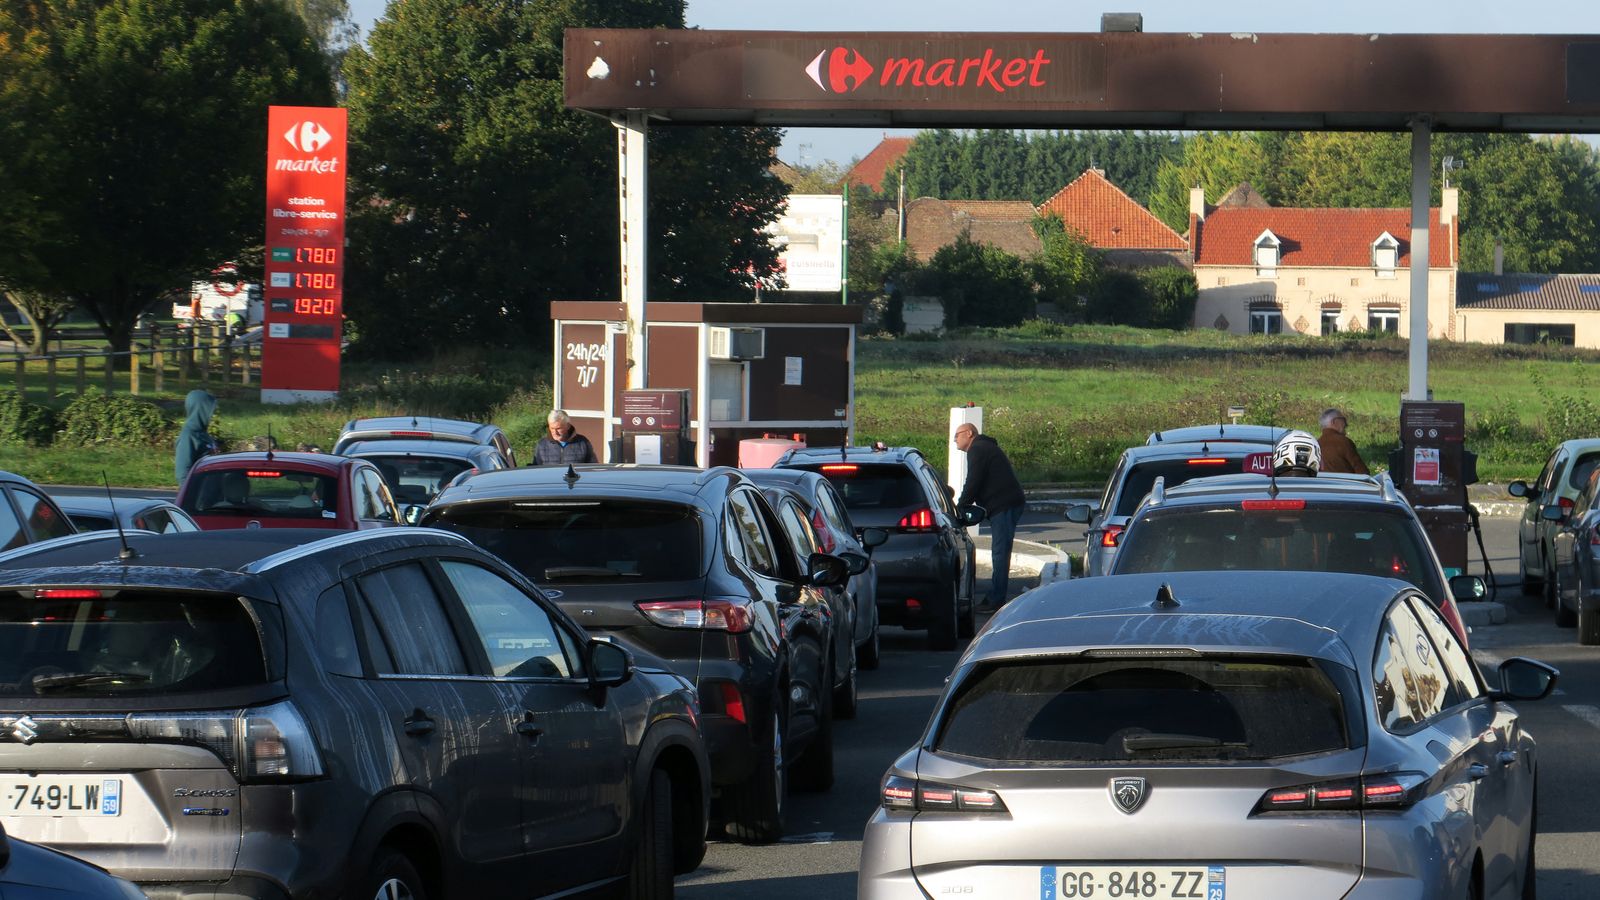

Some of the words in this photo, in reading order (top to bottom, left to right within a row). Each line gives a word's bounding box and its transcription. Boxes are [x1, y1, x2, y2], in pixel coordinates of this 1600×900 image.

[880, 48, 1050, 92] market
[275, 157, 340, 174] market
[288, 196, 325, 206] station
[273, 208, 338, 220] libre-service
[566, 342, 607, 365] 24h/24
[576, 365, 598, 388] 7j/7
[103, 799, 117, 812] 59
[1061, 871, 1204, 898] GG-848-ZZ
[1209, 888, 1223, 900] 29
